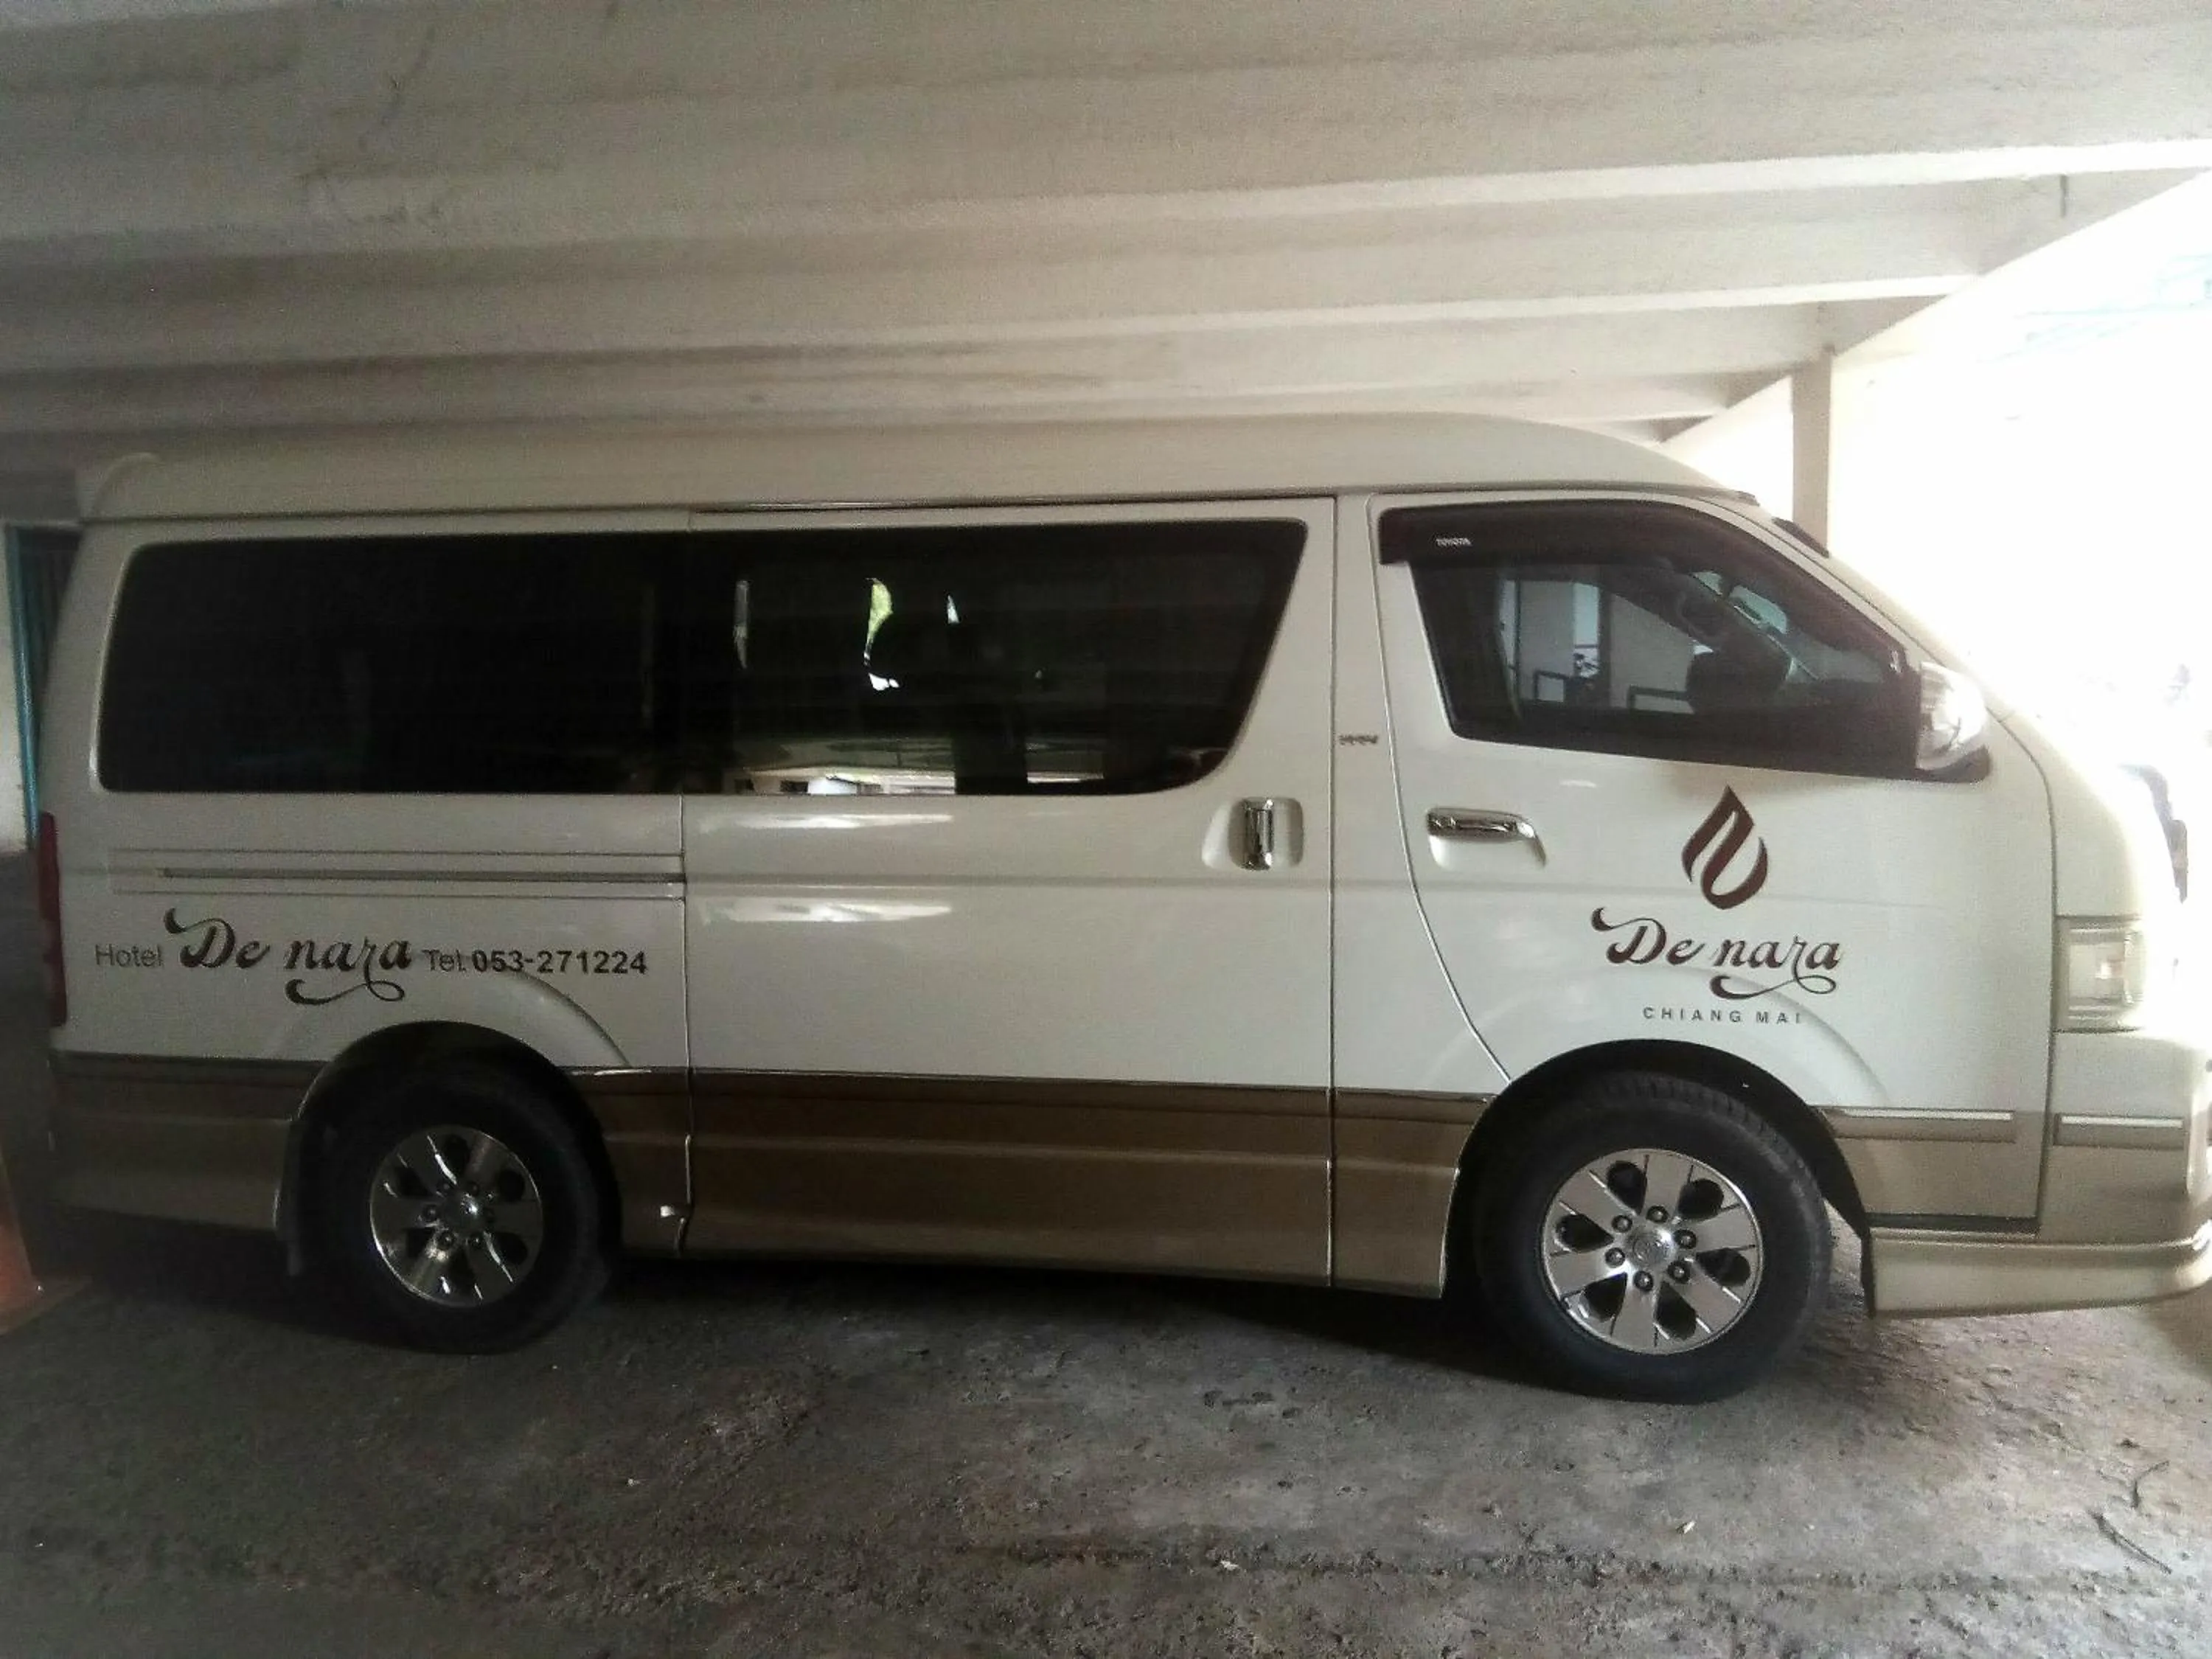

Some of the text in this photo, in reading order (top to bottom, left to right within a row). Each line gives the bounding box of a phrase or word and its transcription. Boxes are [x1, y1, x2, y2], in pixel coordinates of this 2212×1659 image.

[1436, 537, 1472, 546] TOYOTA
[94, 943, 164, 968] Hotel
[163, 908, 271, 968] De
[283, 936, 412, 1005] nara
[470, 948, 647, 975] 053-271224
[1590, 907, 1840, 1000] De nara
[1642, 1006, 1801, 1025] CHIANG MAI
